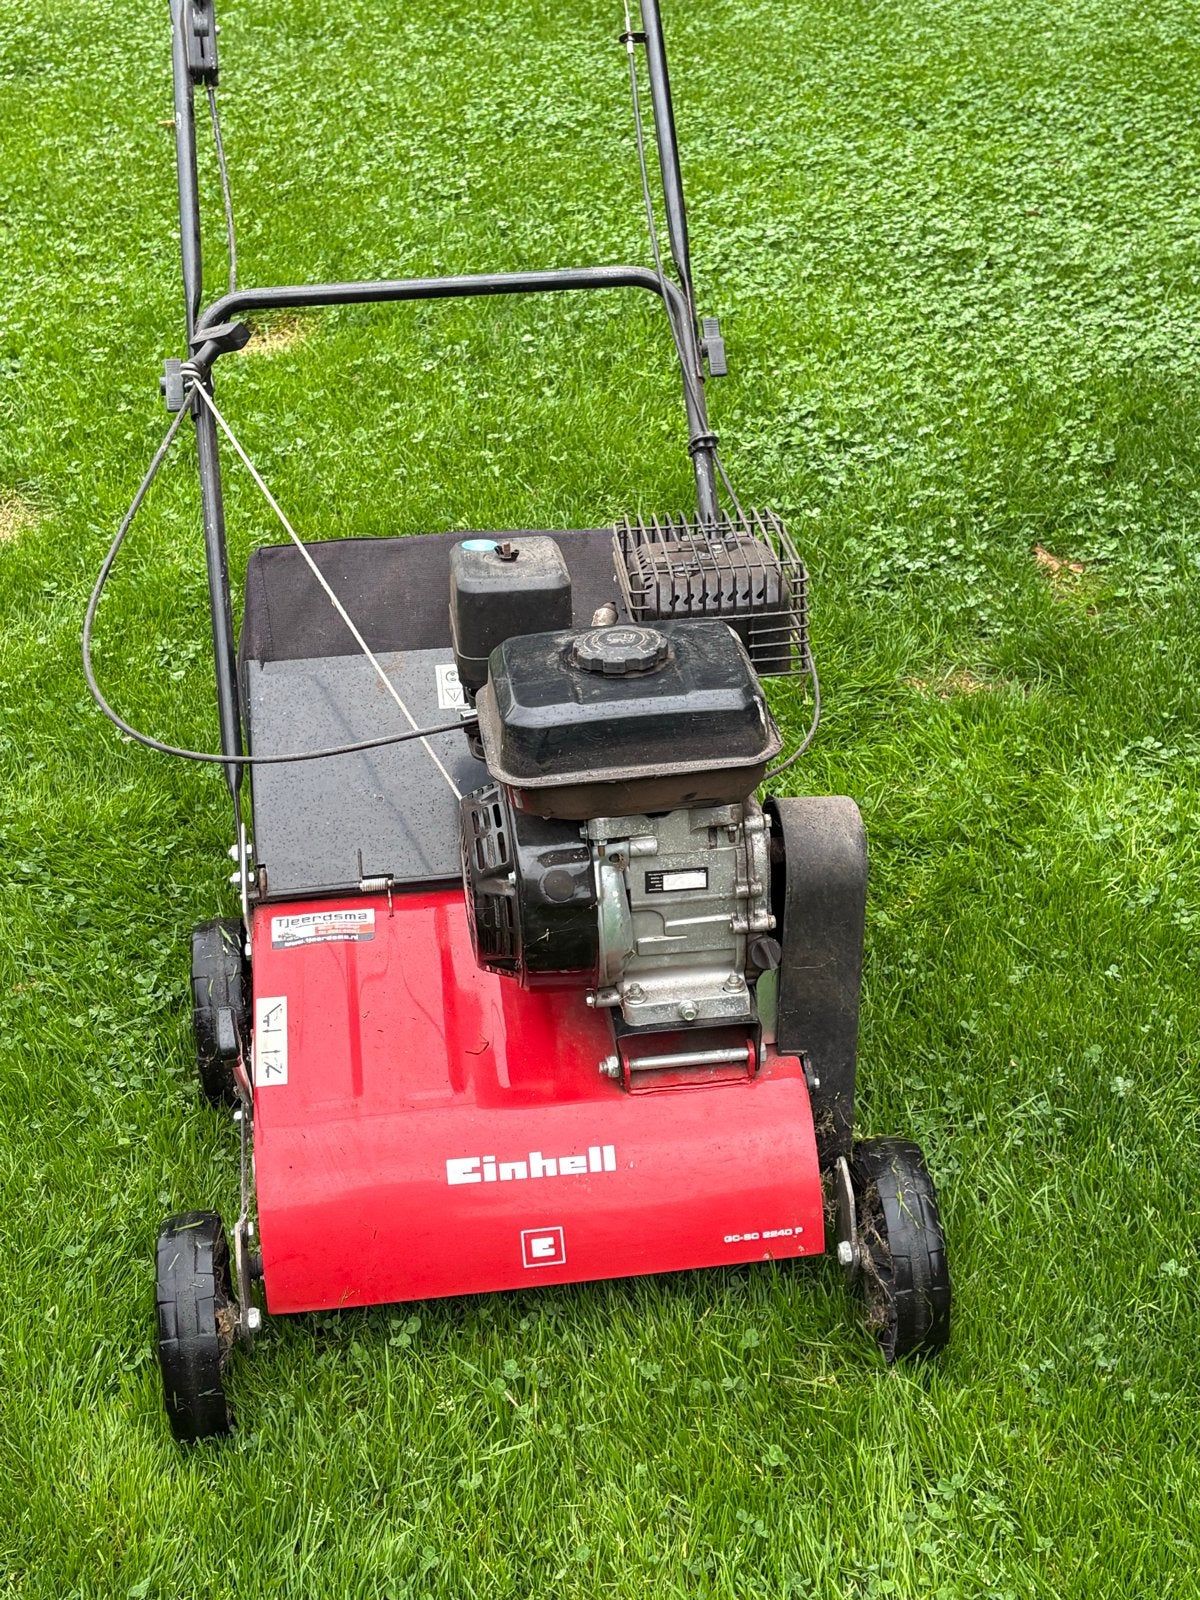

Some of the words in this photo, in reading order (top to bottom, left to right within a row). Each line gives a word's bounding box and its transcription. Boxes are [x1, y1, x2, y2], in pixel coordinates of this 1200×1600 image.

[276, 912, 367, 928] Tjeerdsma
[446, 1145, 617, 1185] Einhell
[762, 1228, 793, 1239] 2240
[794, 1226, 803, 1235] P
